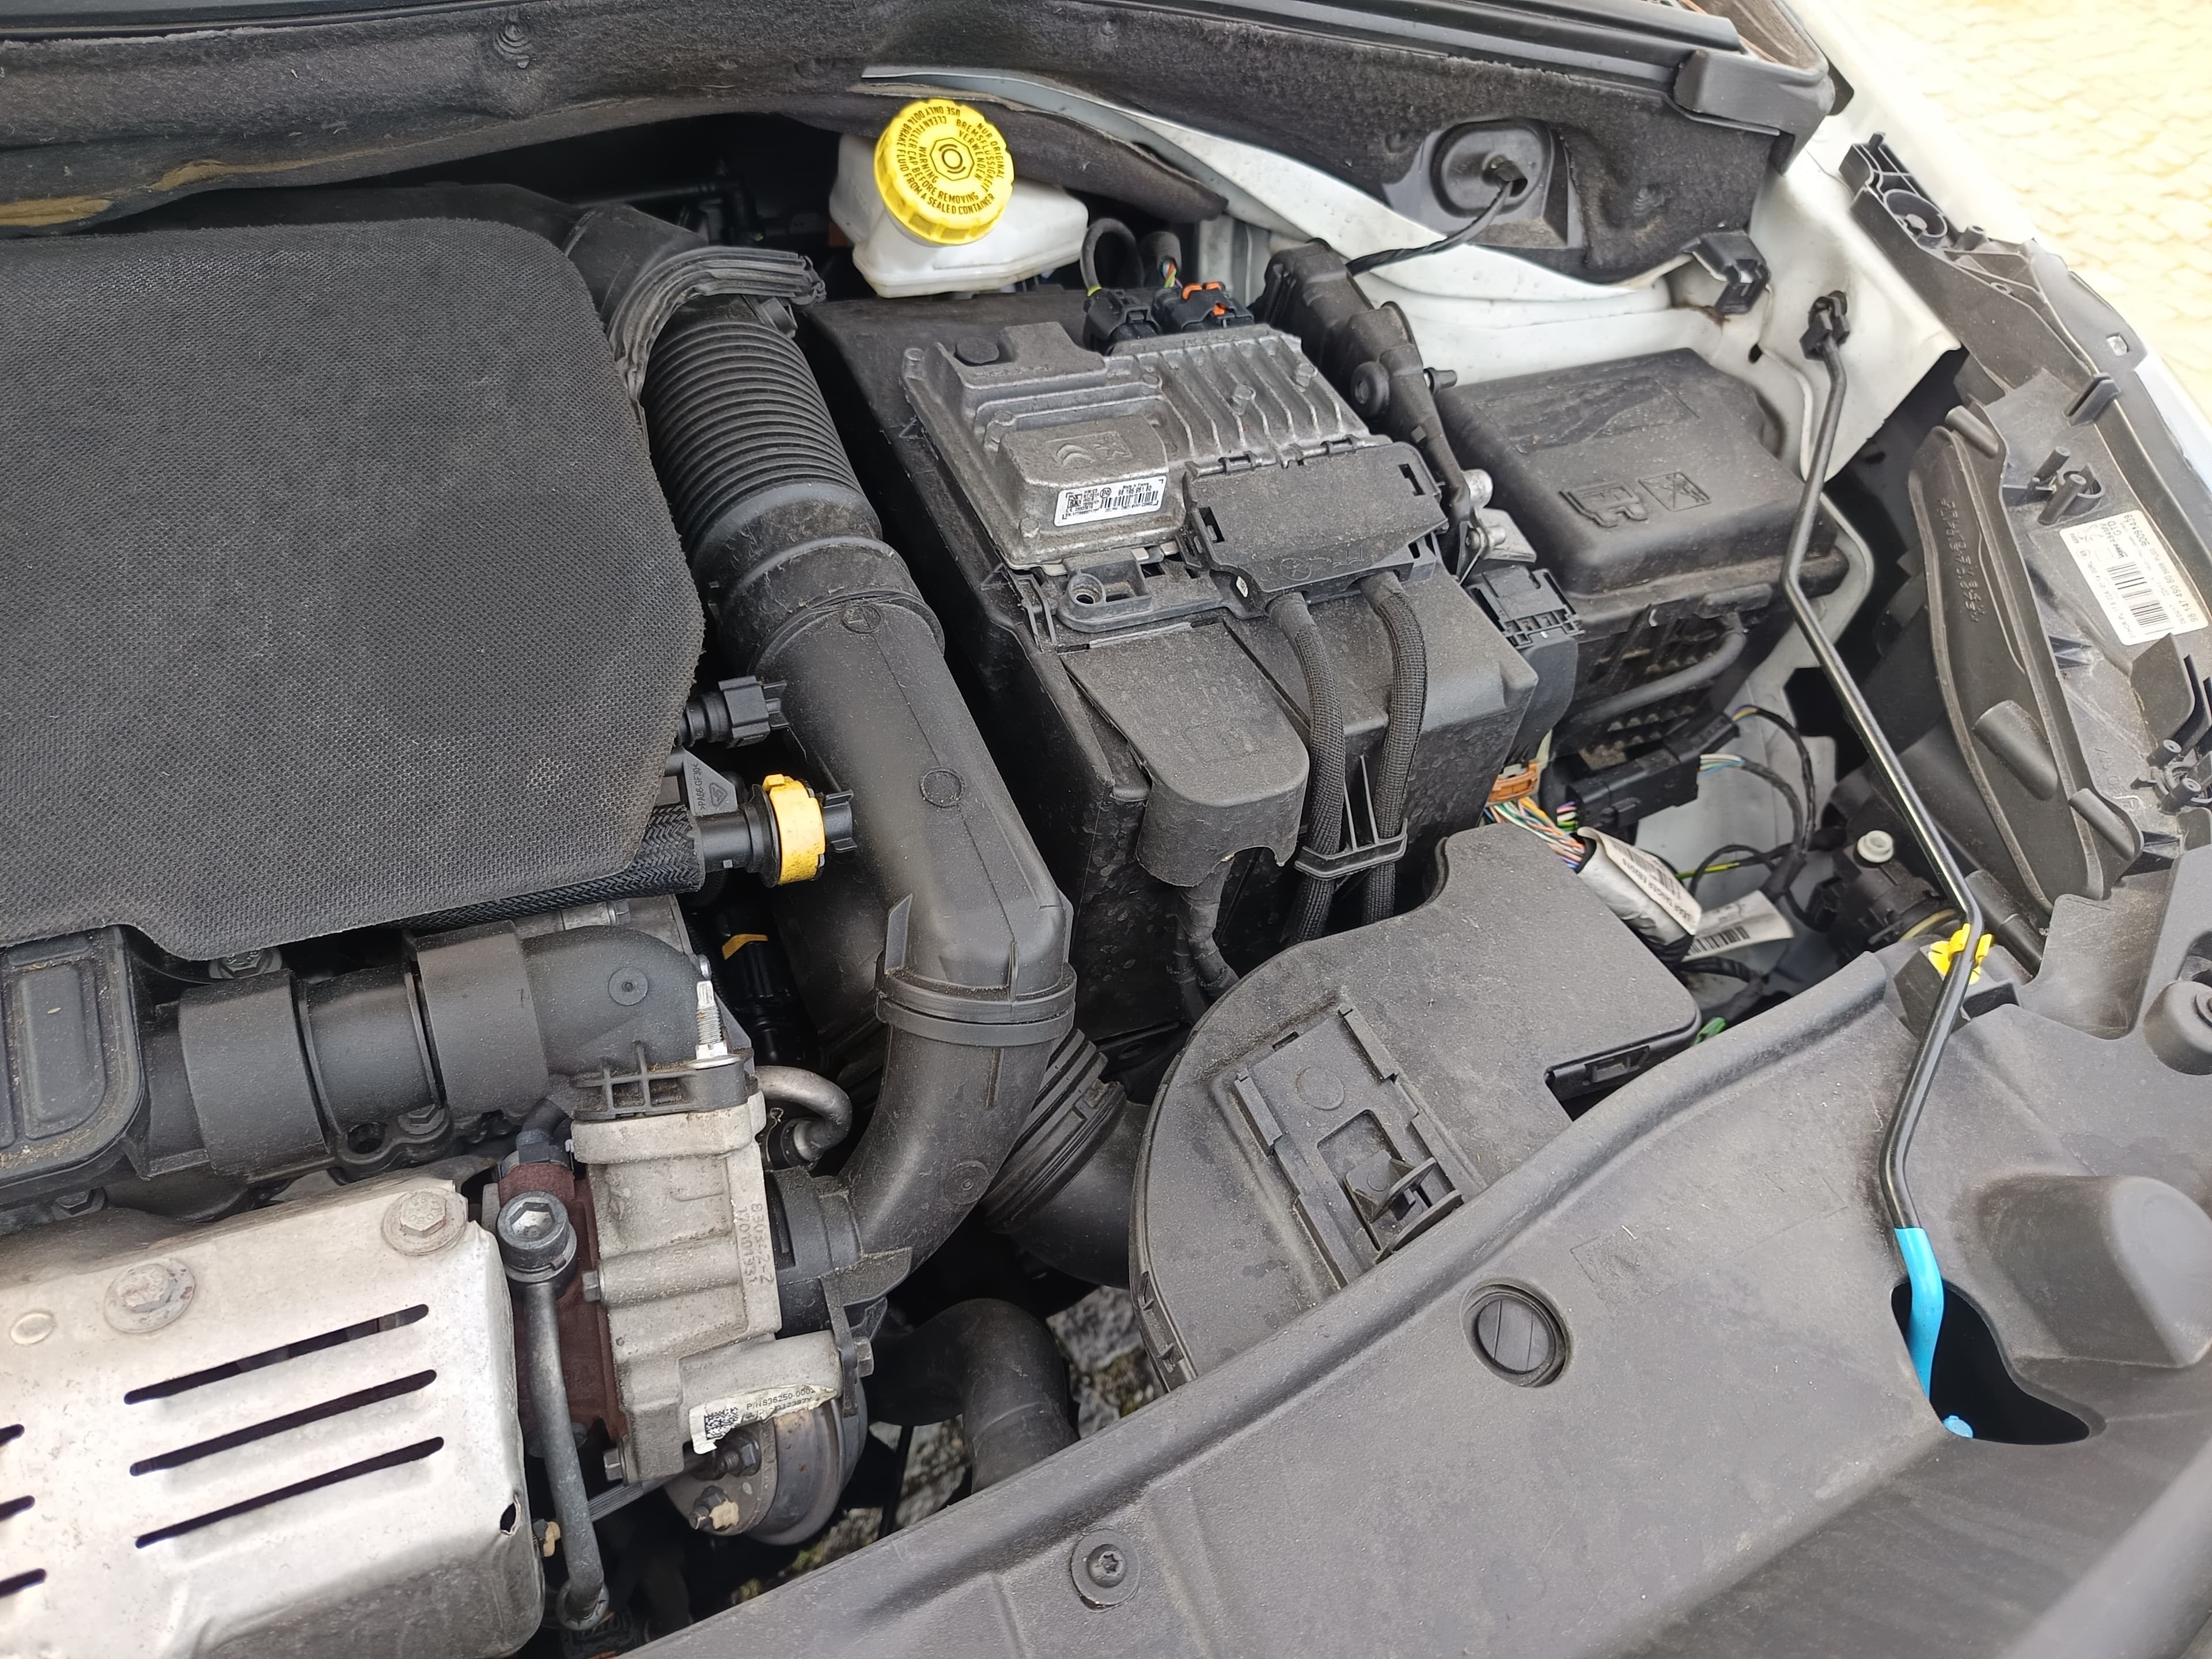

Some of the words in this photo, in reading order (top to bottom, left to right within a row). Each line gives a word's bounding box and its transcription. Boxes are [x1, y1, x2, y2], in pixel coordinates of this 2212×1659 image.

[926, 106, 944, 114] ONLY
[947, 107, 960, 117] USE
[923, 116, 946, 129] CLEAN
[897, 123, 912, 147] BRAKE
[908, 125, 925, 149] FILLER
[897, 149, 909, 172] FLUID
[908, 151, 918, 165] CAP
[959, 131, 986, 181] VERWENDEN
[977, 123, 993, 138] NUR
[990, 141, 1005, 179] ORIGINAL
[919, 146, 938, 183] WARNING
[903, 173, 923, 195] FROM
[912, 167, 937, 195] BEFORE
[927, 198, 956, 214] SEALED
[938, 191, 978, 203] REMOVING
[959, 193, 995, 214] CONTAINER
[2107, 521, 2122, 536] GTD
[2178, 600, 2191, 611] 147
